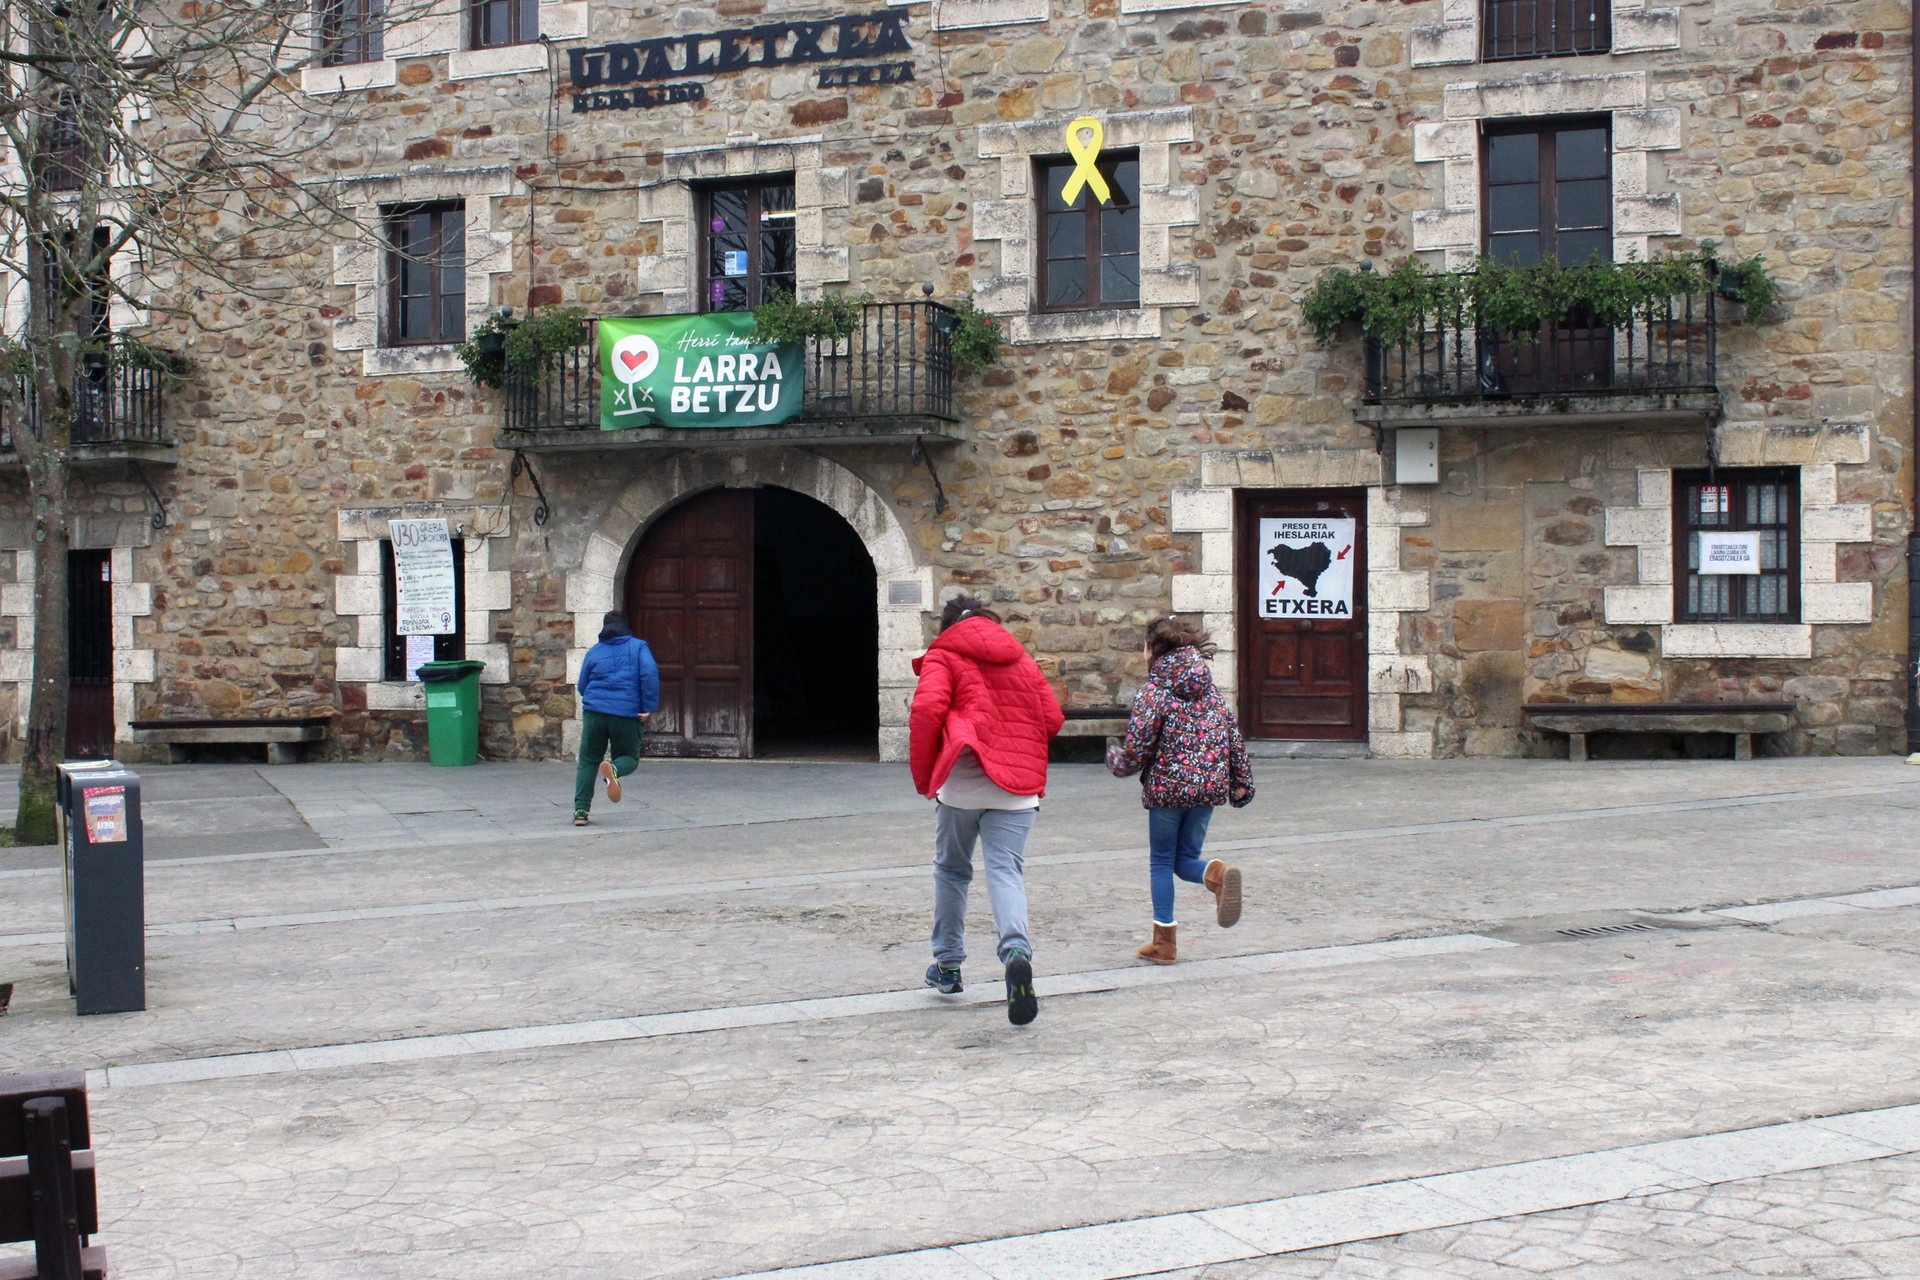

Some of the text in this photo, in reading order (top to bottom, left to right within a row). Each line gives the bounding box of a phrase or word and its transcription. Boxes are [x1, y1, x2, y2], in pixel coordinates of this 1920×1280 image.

[566, 8, 914, 86] UDALETXEA
[817, 61, 916, 88] ETXEA
[677, 329, 721, 352] Herri
[673, 352, 783, 383] LARRA
[671, 383, 780, 413] BETZU
[1274, 531, 1336, 539] IHESLARIAK
[1265, 599, 1348, 614] ETXERA
